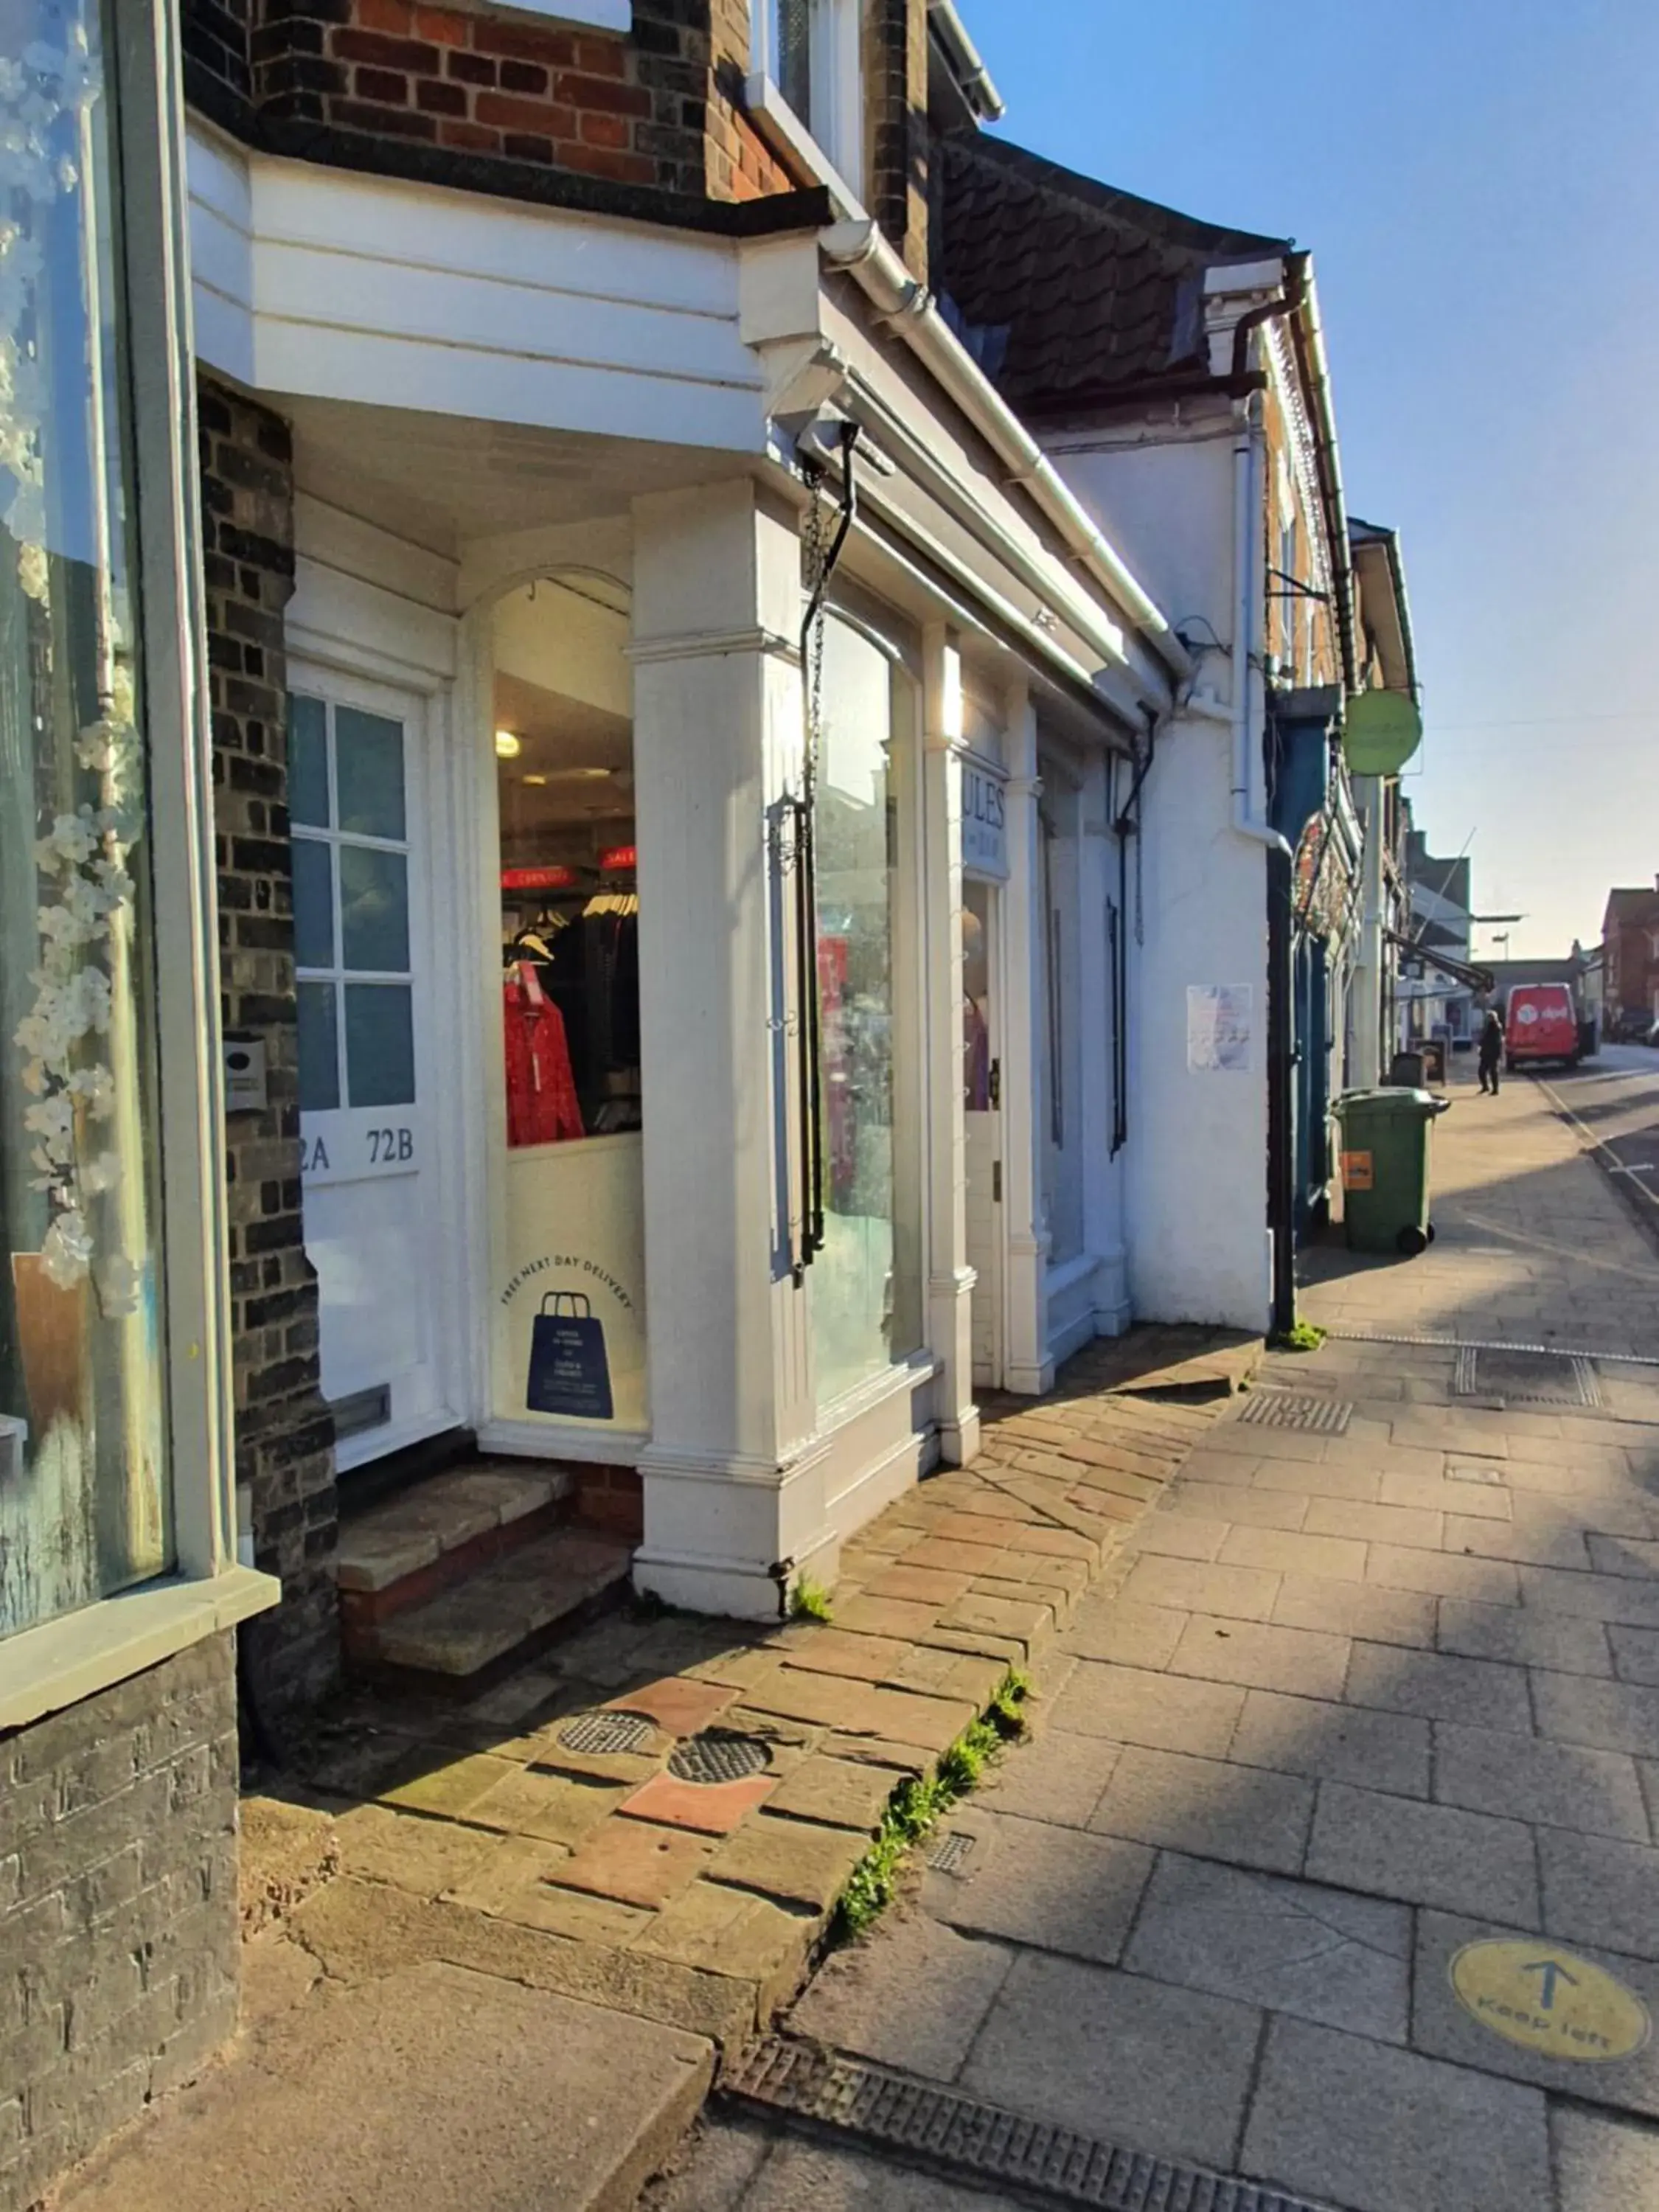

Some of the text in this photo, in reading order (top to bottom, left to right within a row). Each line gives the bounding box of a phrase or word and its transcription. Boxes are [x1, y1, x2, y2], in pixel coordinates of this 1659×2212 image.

[299, 1137, 330, 1171] 2A
[366, 1128, 414, 1163] 72B
[501, 1255, 633, 1309] FREE NEXT DAY DELIVERY
[1477, 1994, 1551, 2029] Keep
